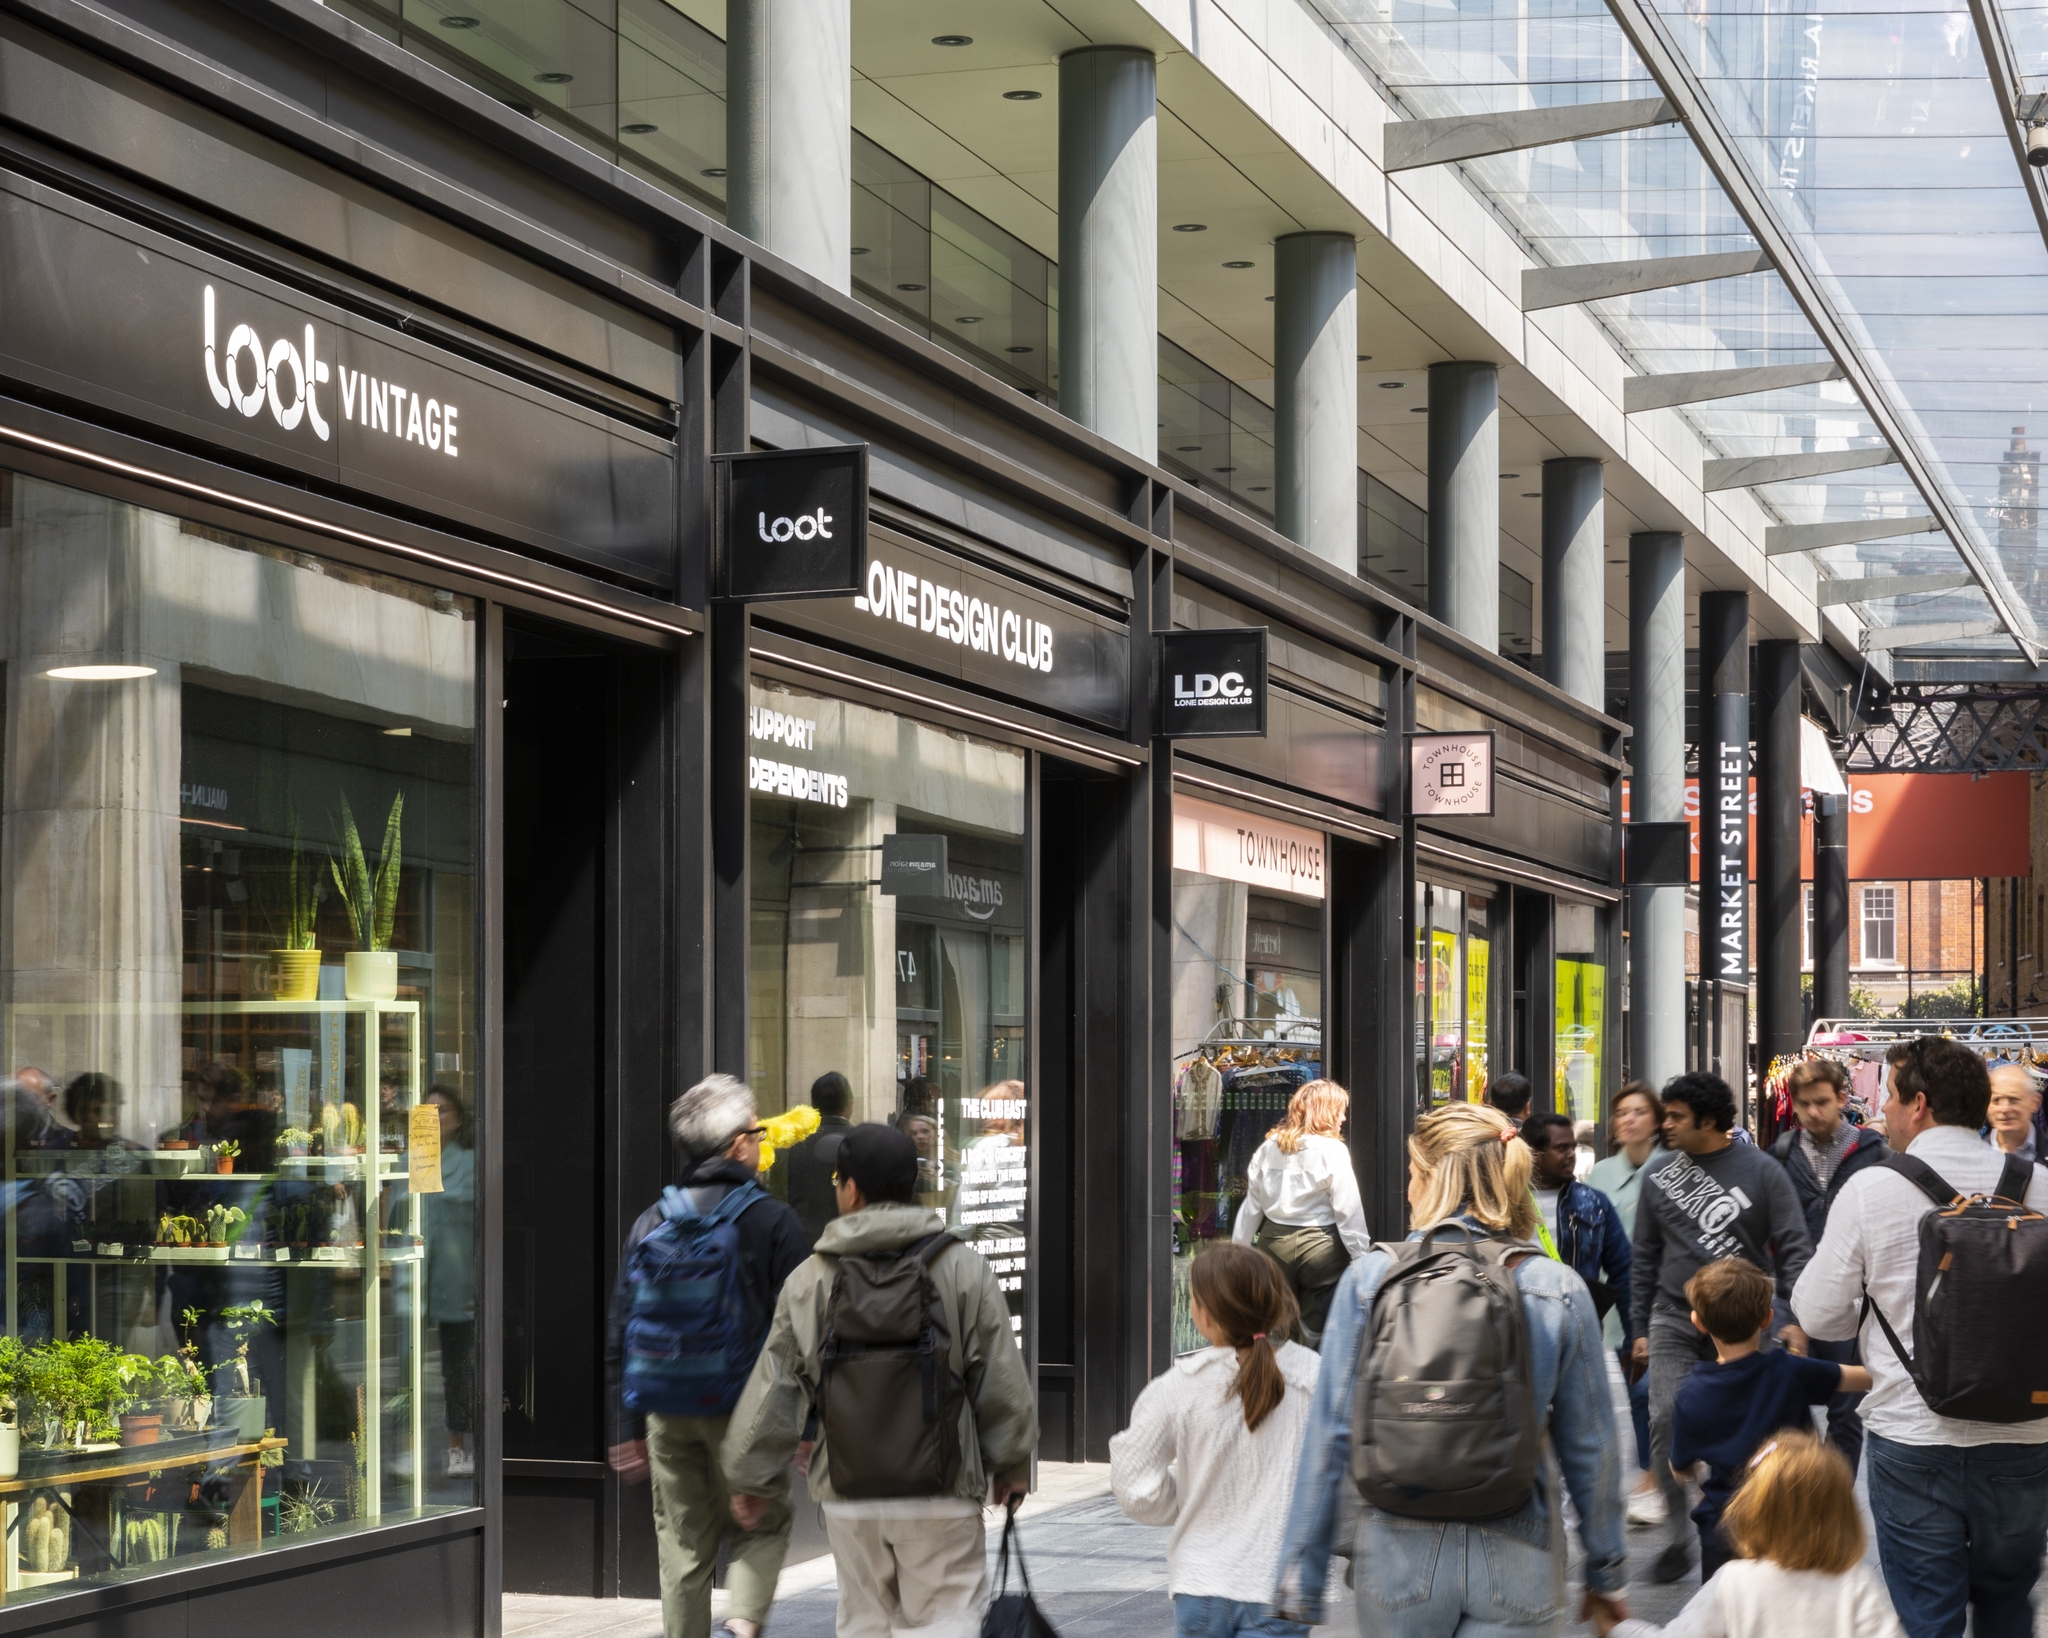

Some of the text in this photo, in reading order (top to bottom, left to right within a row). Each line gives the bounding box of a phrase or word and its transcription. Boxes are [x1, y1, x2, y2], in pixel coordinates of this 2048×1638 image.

[338, 365, 458, 457] VINTAGE
[854, 560, 1053, 673] ONE DESIGN CLUB
[1174, 672, 1252, 698] LDC.
[1174, 697, 1252, 707] LONE DESIGN CLUB
[1423, 744, 1482, 770] TOWNHOUSE
[1424, 781, 1482, 806] TOWNHOUSE
[1237, 828, 1320, 881] TOWNHOUSE
[1720, 741, 1742, 975] MARKET STREET
[961, 1098, 1027, 1119] THE CLUB EAST
[997, 1169, 1008, 1182] THE
[980, 1190, 988, 1204] OF
